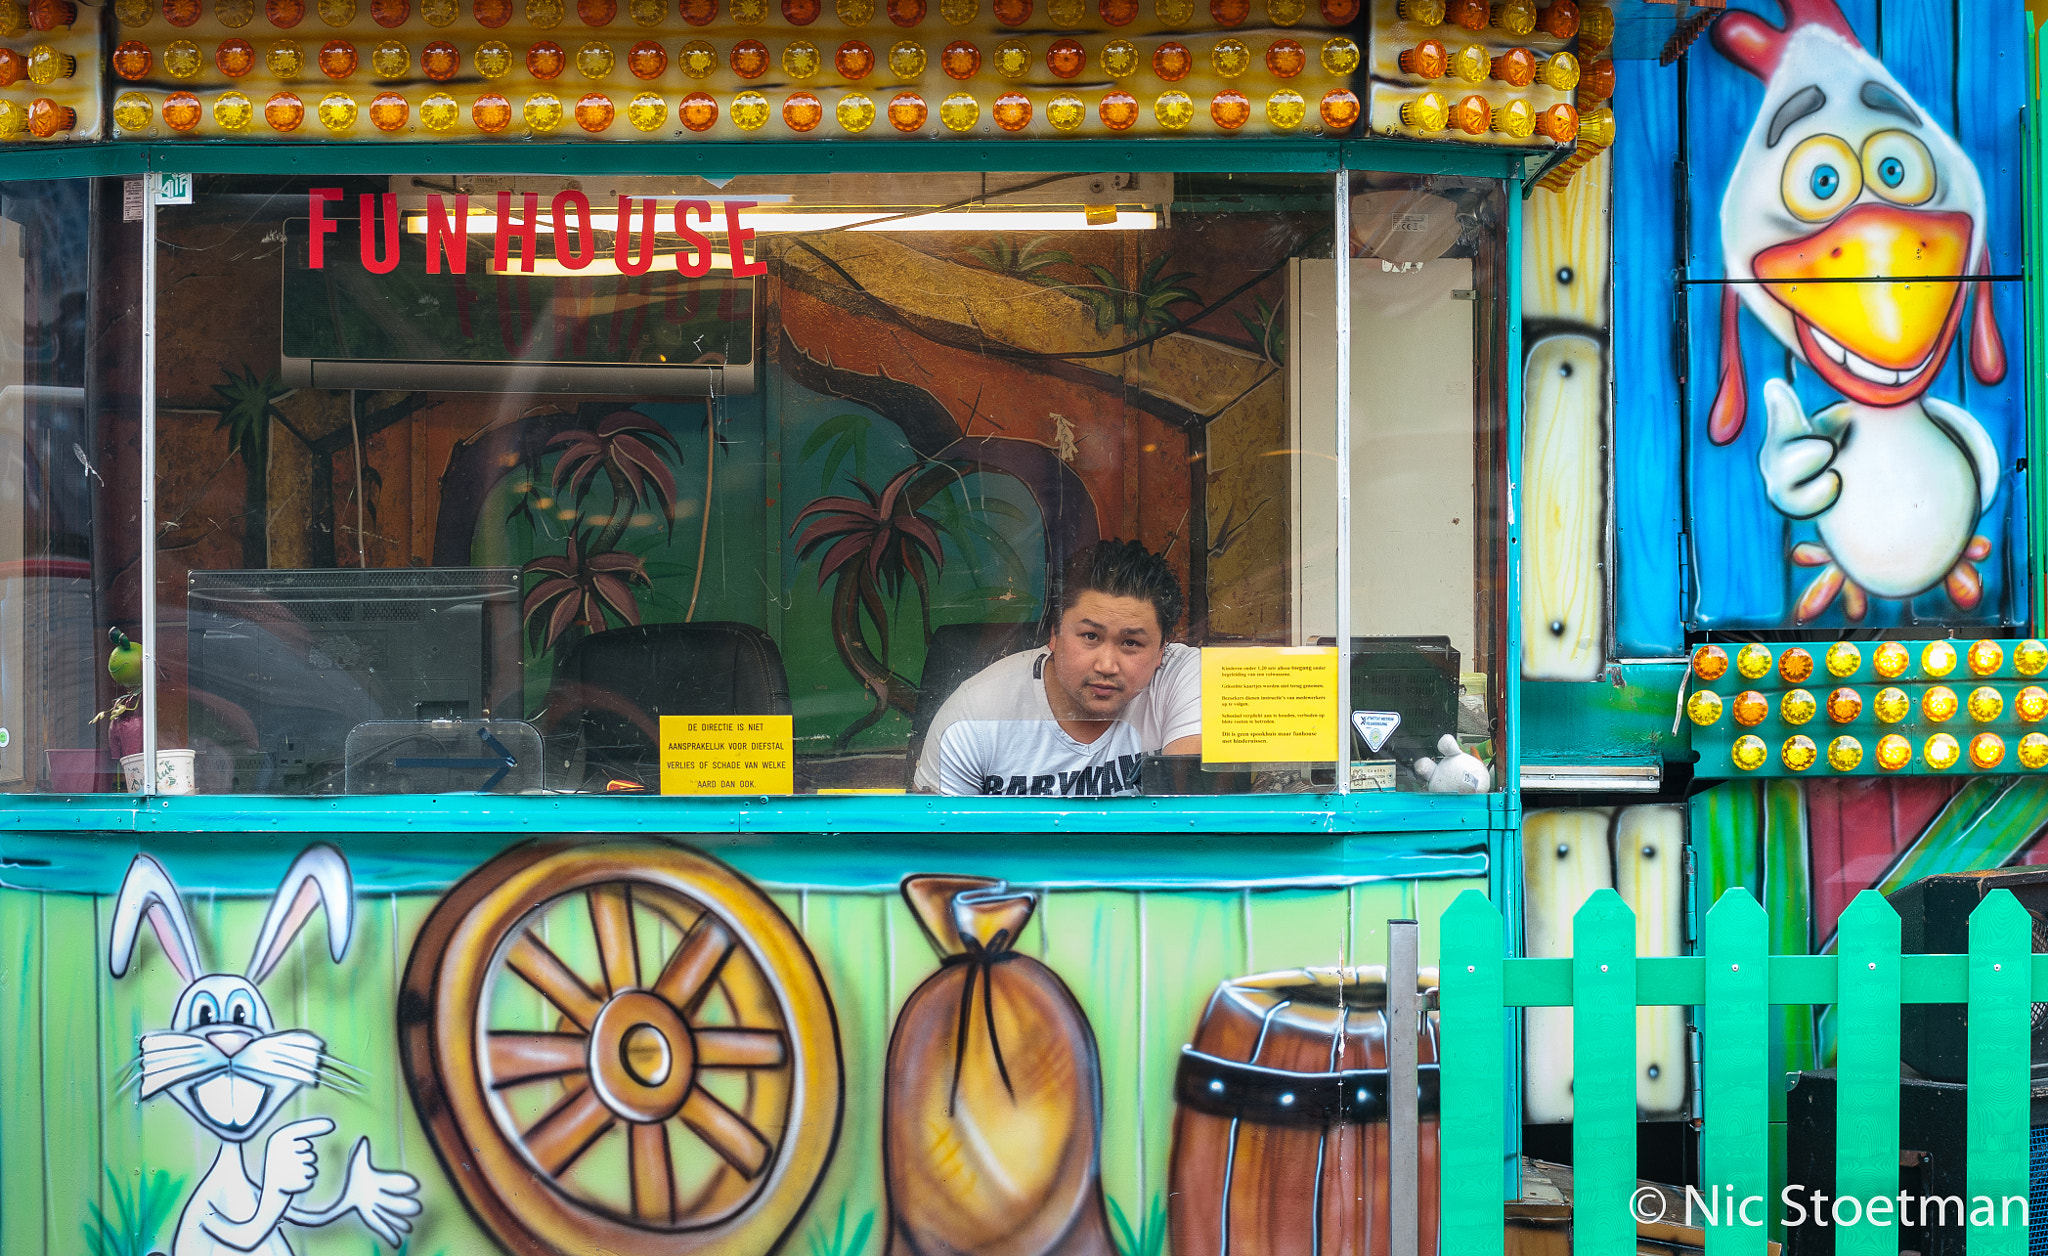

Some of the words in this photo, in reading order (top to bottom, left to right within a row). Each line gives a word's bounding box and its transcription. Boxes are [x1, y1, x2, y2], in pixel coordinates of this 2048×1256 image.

[308, 187, 768, 279] FUNHOUSE
[687, 723, 698, 732] DE
[701, 723, 733, 732] DIRECTIE
[737, 723, 744, 732] IS
[748, 723, 764, 732] NIET
[668, 742, 725, 750] AANSPRAKELIJK
[728, 742, 747, 750] VOOR
[751, 742, 785, 750] DIEFSTAL
[667, 761, 695, 770] VERLIES
[699, 761, 709, 770] OF
[712, 761, 741, 770] SCHADE
[744, 761, 759, 770] VAN
[762, 761, 786, 770] WELKE
